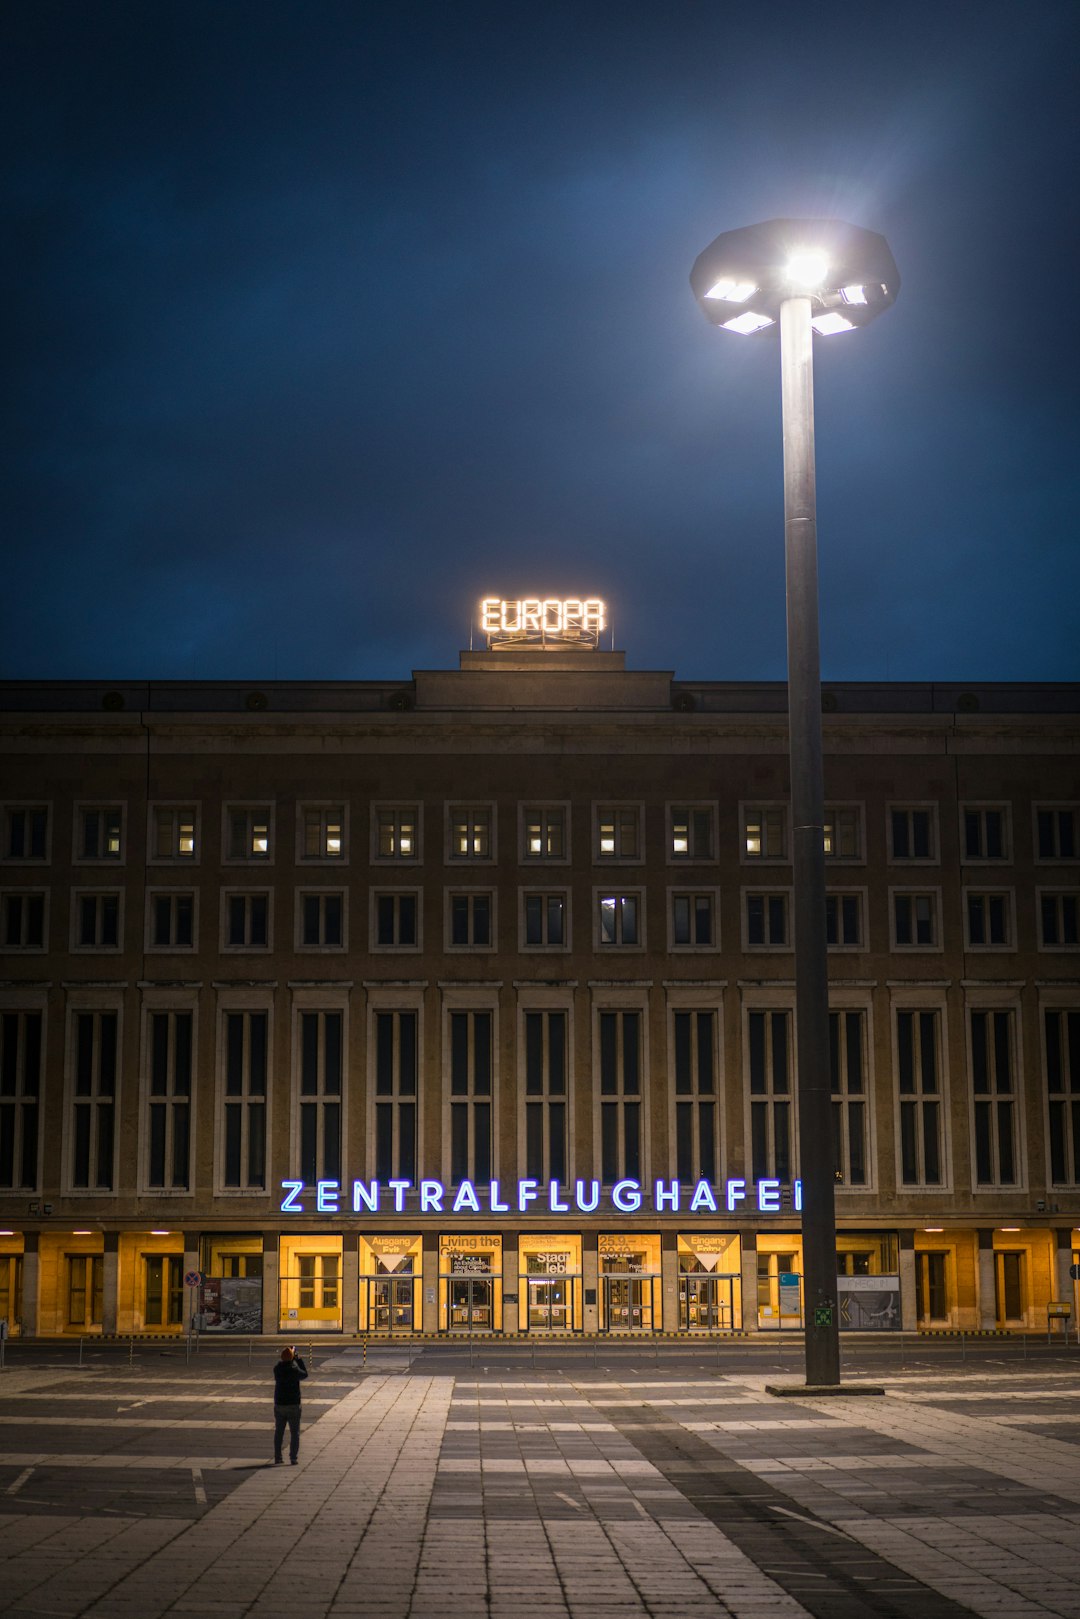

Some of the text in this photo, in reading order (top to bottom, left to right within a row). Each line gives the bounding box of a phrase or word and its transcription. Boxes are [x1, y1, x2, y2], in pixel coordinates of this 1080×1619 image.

[481, 598, 605, 632] EUROPA
[280, 1180, 802, 1212] ZENTRALFLUGHAFE
[372, 1237, 411, 1247] Ausgang
[440, 1236, 500, 1249] Living the
[690, 1236, 727, 1247] Eingang
[440, 1247, 465, 1260] City
[696, 1244, 721, 1254] Entry
